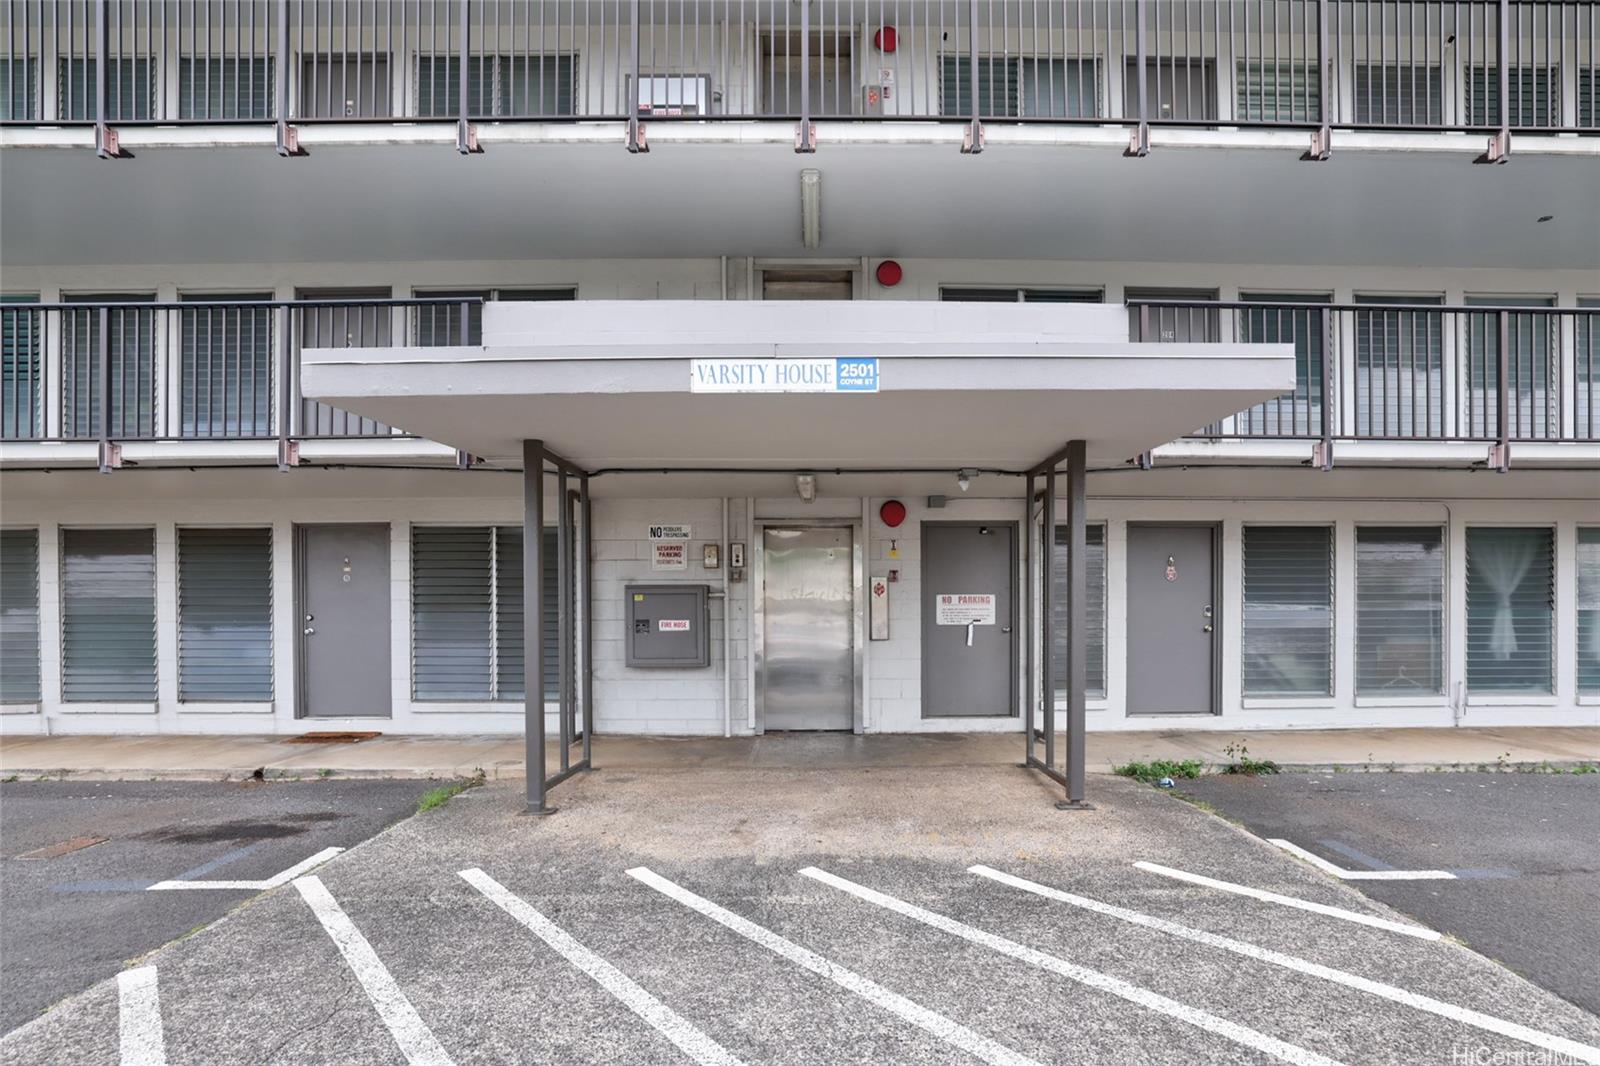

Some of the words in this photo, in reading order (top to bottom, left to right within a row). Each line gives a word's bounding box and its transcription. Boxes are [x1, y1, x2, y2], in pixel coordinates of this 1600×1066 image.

[697, 364, 769, 384] VARSITY
[775, 364, 832, 384] HOUSE
[840, 363, 874, 377] 2501
[650, 526, 663, 538] NO
[942, 596, 953, 604] NO
[958, 595, 991, 604] PARKING
[660, 621, 673, 629] FIRE
[673, 621, 688, 629] HOSE
